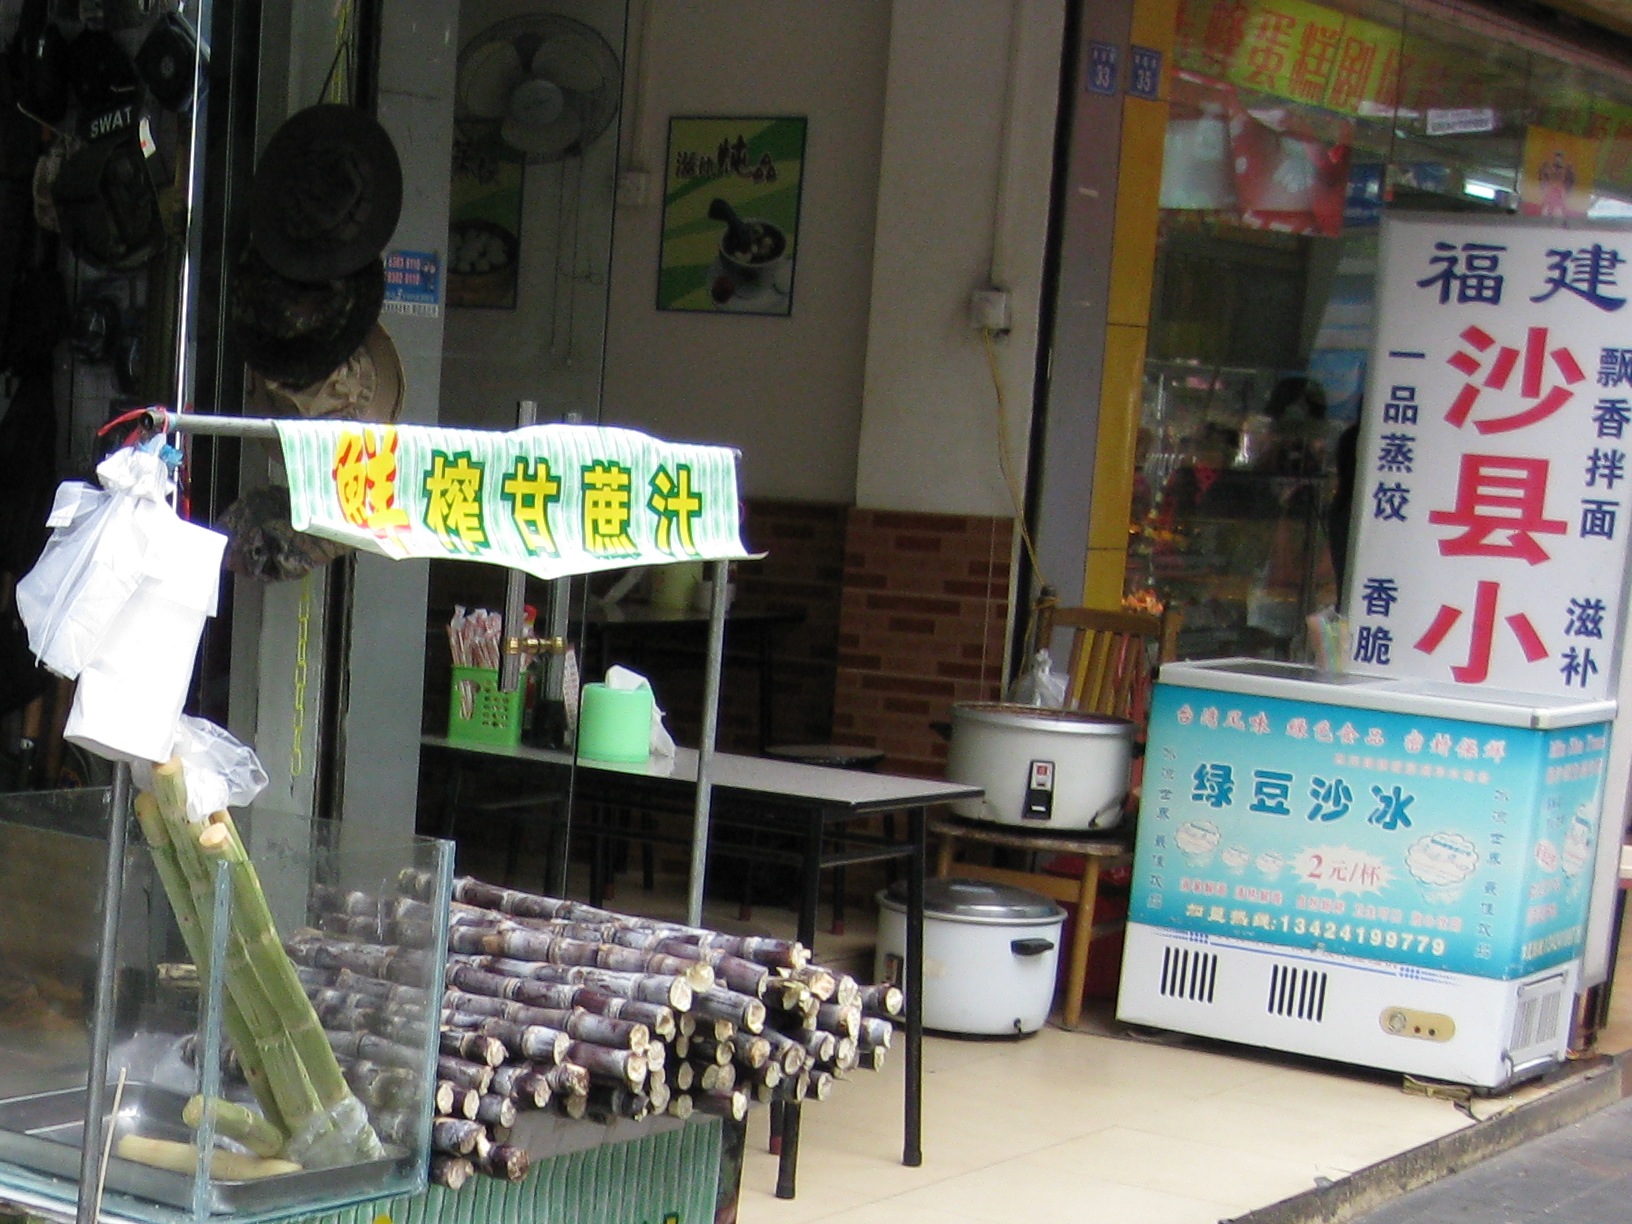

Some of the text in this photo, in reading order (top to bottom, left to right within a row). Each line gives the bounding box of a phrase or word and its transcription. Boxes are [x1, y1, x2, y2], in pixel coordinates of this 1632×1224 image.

[90, 105, 132, 139] SWAT
[1416, 241, 1629, 313] 福建
[1579, 346, 1632, 540] 飘香拌面
[332, 424, 704, 560] 鲜榨甘蔗汁
[1353, 348, 1426, 666] 一品蒸饺 香脆
[1413, 324, 1586, 684] 沙县小
[1559, 597, 1607, 688] 滋补
[1191, 763, 1416, 830] 绿豆沙冰
[1306, 853, 1382, 887] 2元/杯
